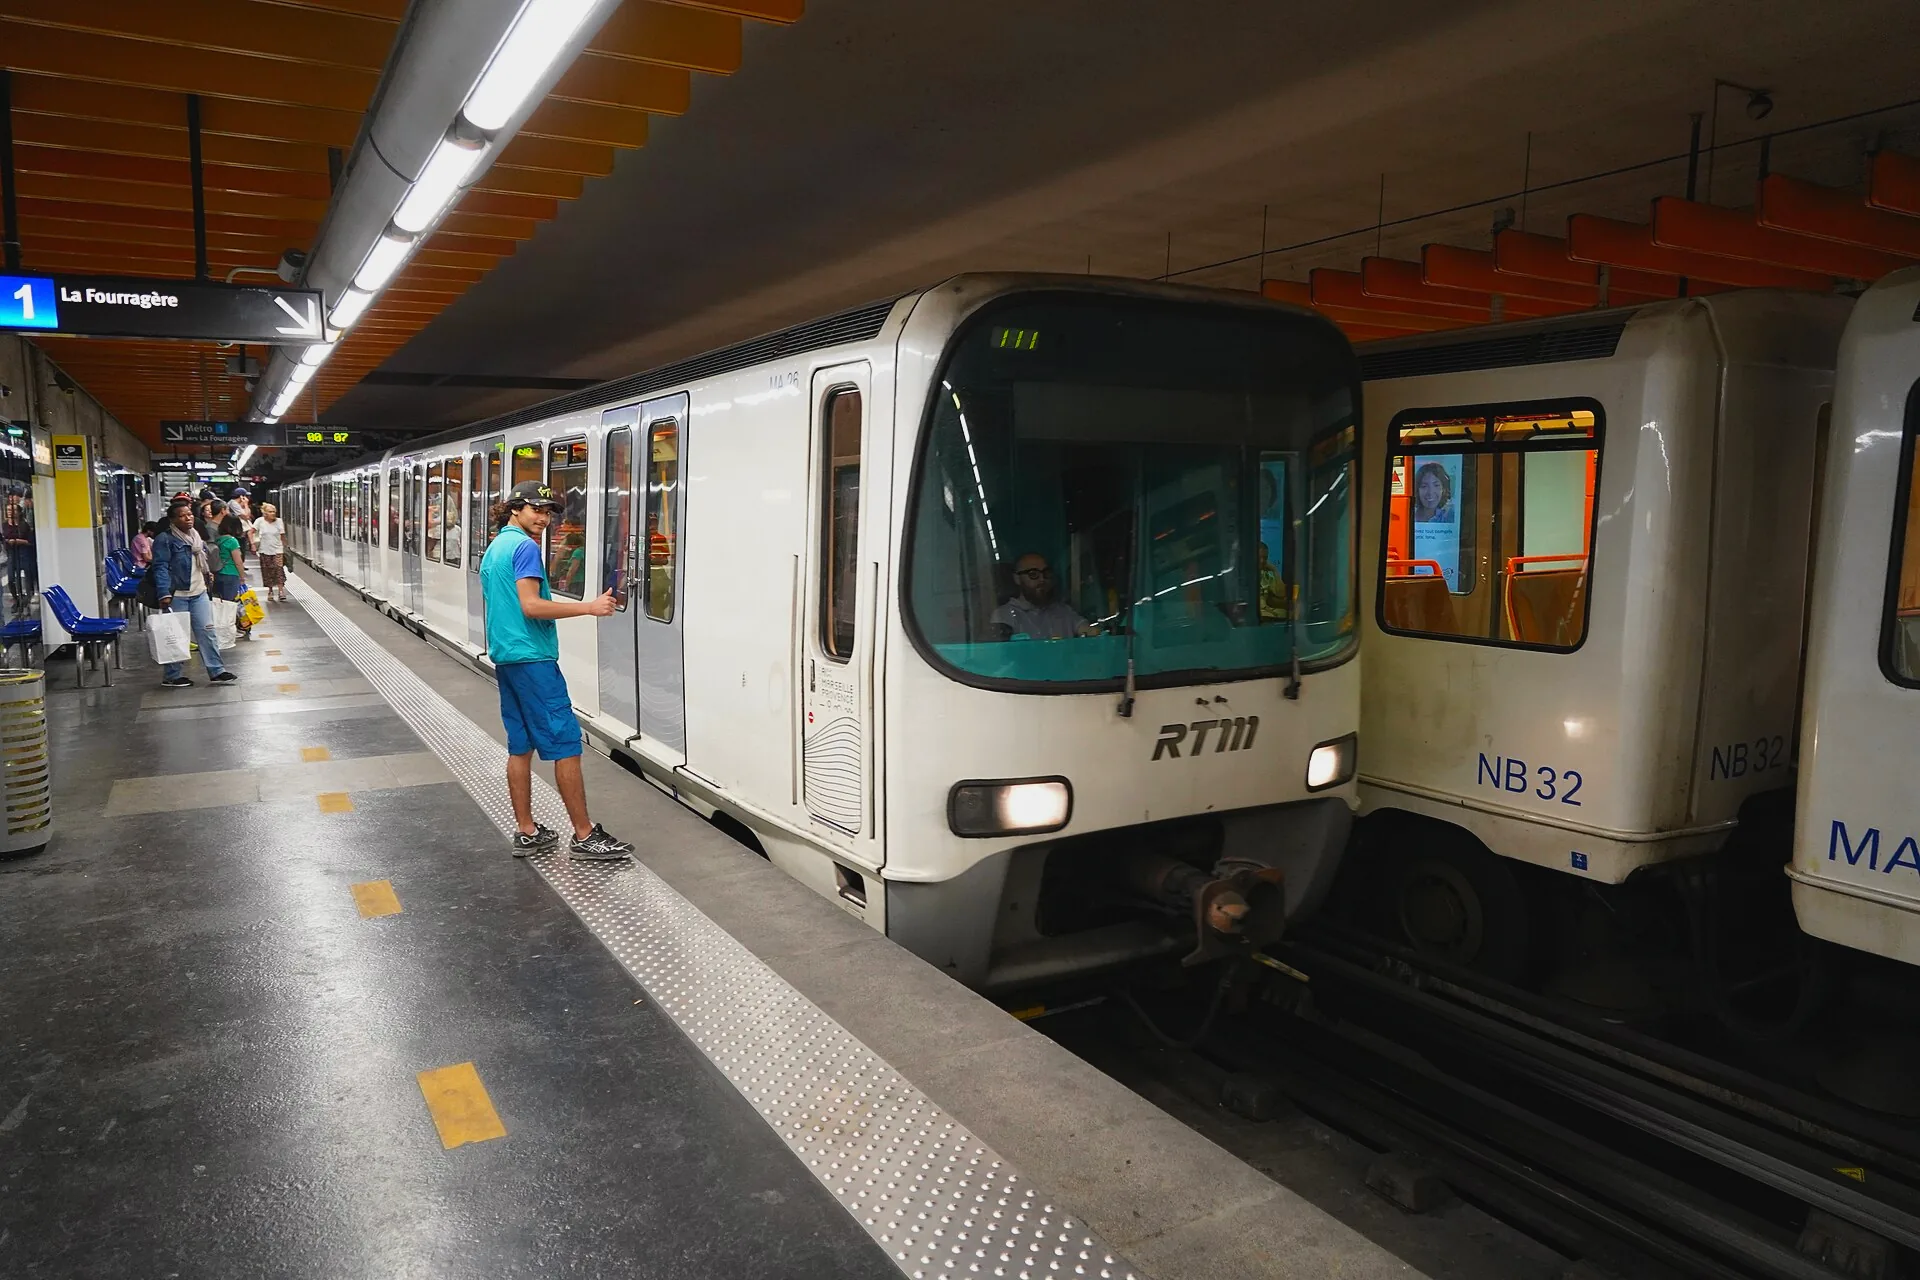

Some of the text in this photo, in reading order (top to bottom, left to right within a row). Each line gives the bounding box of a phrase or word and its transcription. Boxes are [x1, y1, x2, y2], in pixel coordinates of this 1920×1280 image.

[13, 284, 179, 320] 1 La Fourragère
[184, 423, 213, 433] Métro
[209, 434, 248, 443] Fourragère
[333, 432, 349, 442] 07
[1151, 716, 1259, 761] RTM
[1710, 736, 1784, 781] NB 32
[1477, 752, 1583, 807] NB 32
[1828, 819, 1920, 876] MA
